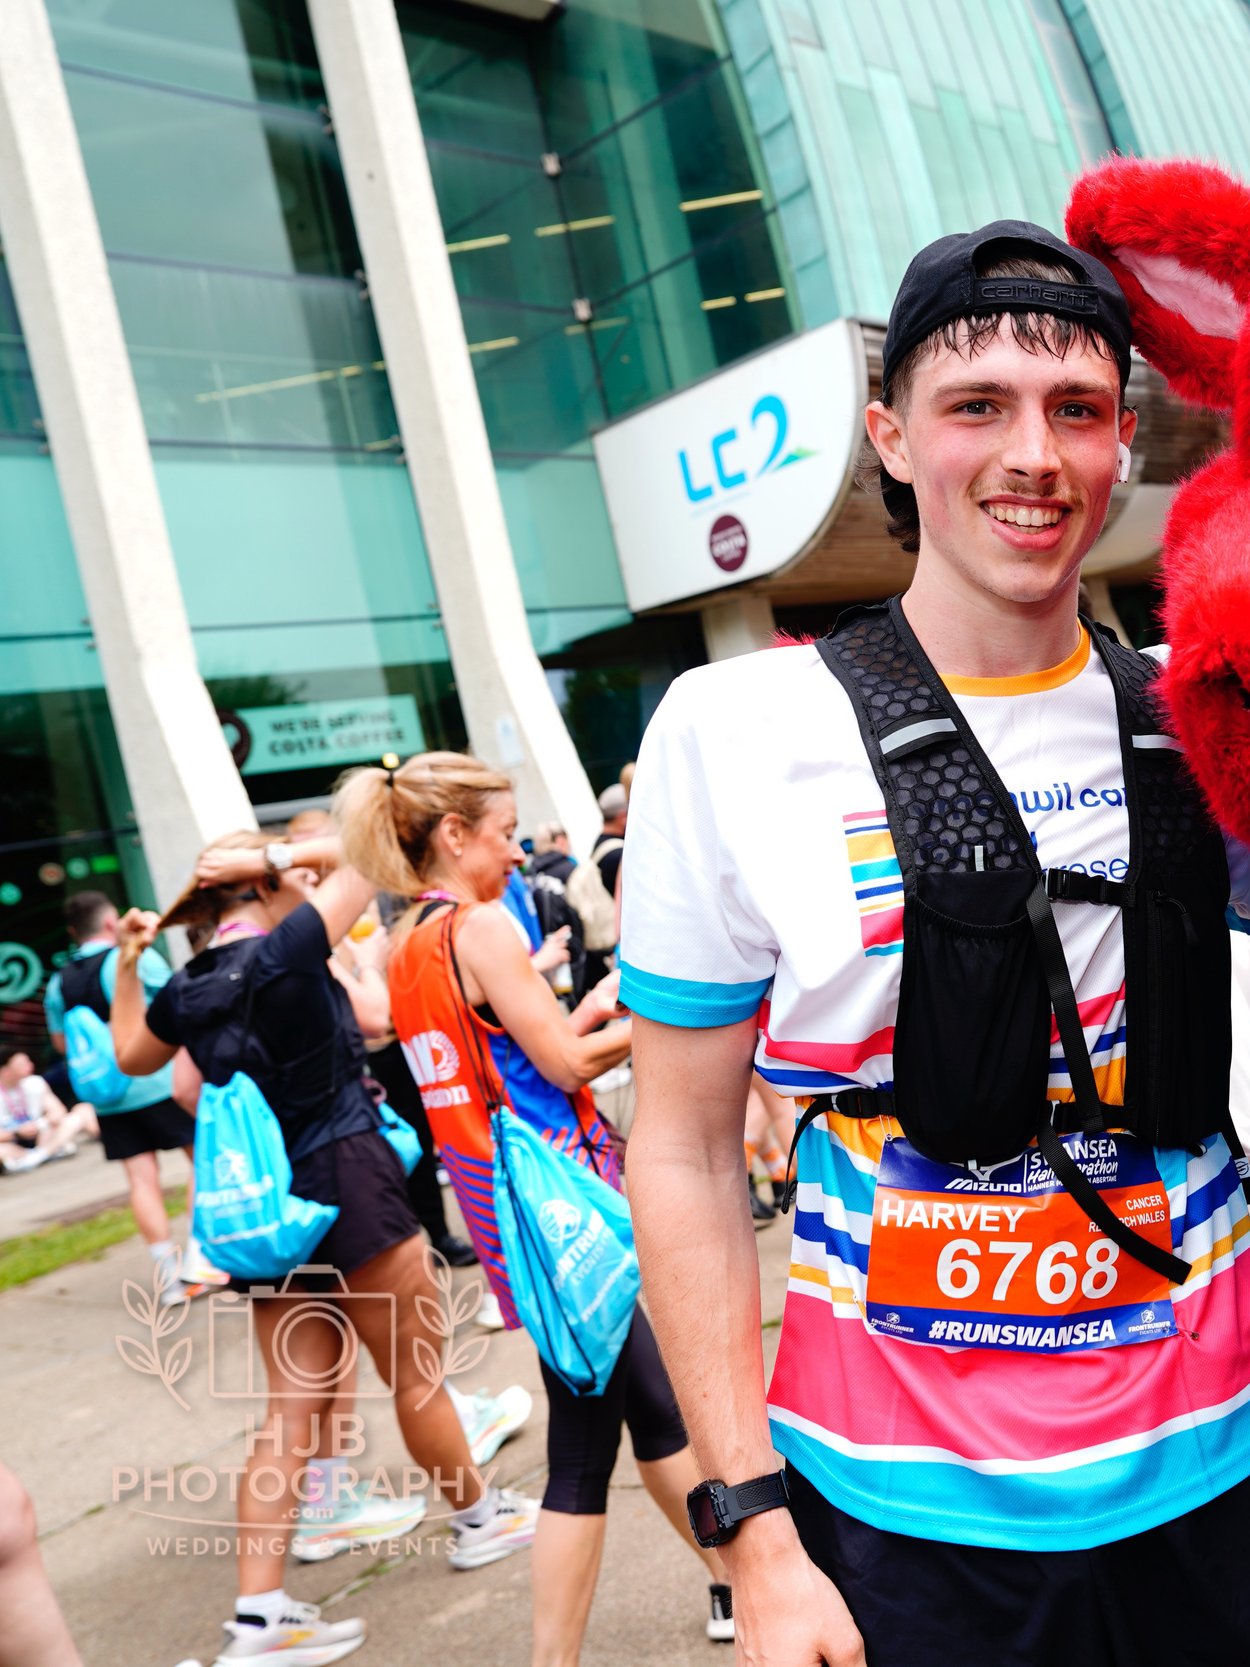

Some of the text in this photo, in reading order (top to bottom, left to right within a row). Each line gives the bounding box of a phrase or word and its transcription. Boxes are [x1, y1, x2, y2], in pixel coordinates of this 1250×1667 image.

[981, 284, 1089, 306] carhartt
[1126, 1194, 1164, 1211] CANCER
[880, 1199, 1026, 1233] HARVEY
[1137, 1210, 1166, 1225] WALES
[935, 1238, 1120, 1305] 6768
[928, 1319, 1117, 1348] #RUNSWANSEA
